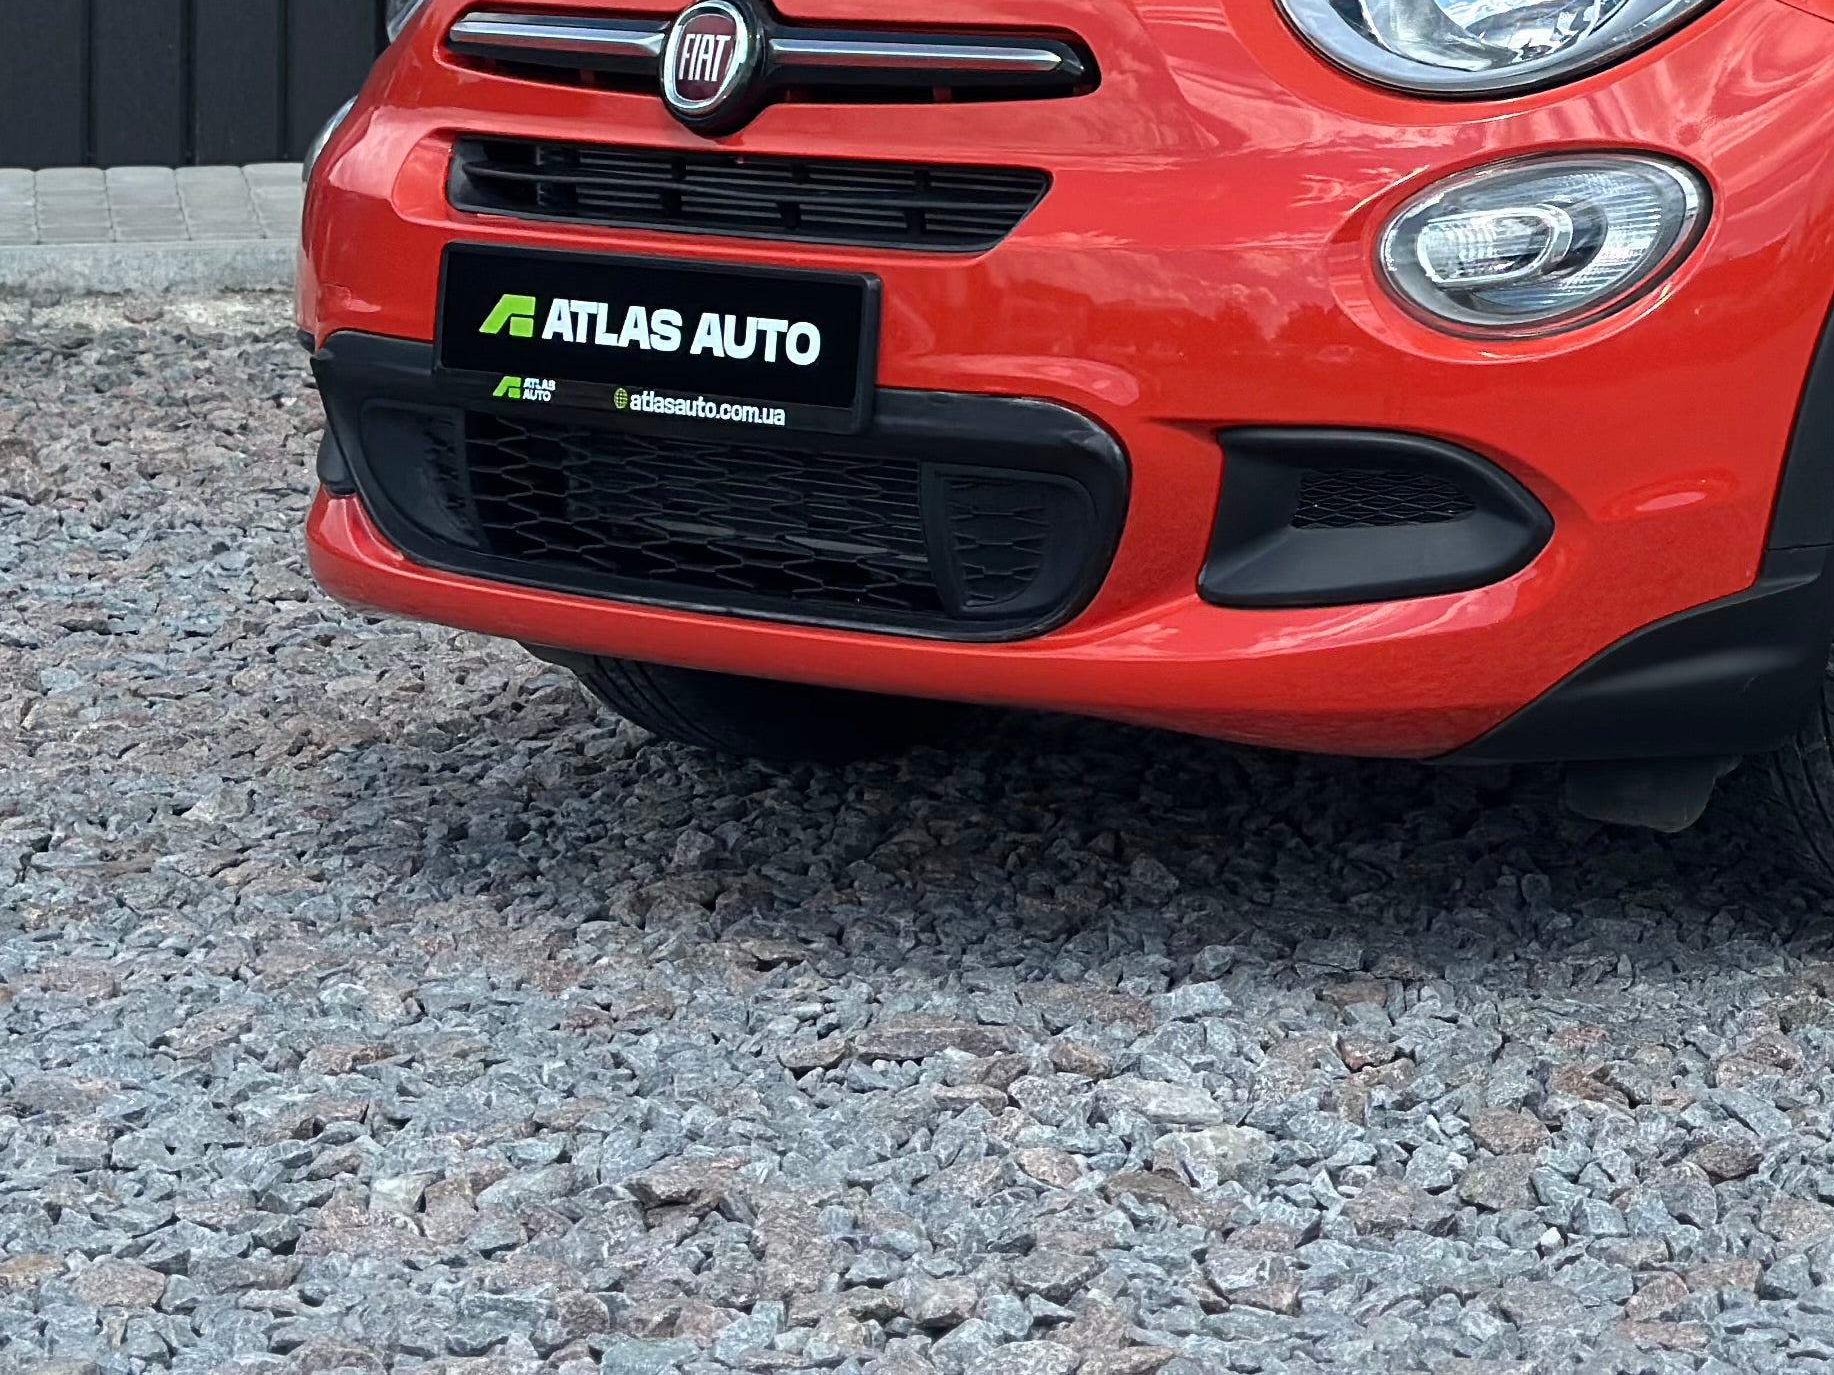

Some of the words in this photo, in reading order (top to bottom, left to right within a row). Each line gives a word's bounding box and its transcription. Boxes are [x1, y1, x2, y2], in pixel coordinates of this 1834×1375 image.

[678, 33, 732, 82] FIAT
[541, 298, 683, 352] ATLAS
[689, 312, 821, 366] AUTO
[522, 388, 552, 402] AUTO
[523, 377, 556, 392] ATLAS
[629, 390, 786, 426] atlasauto.com.ua
